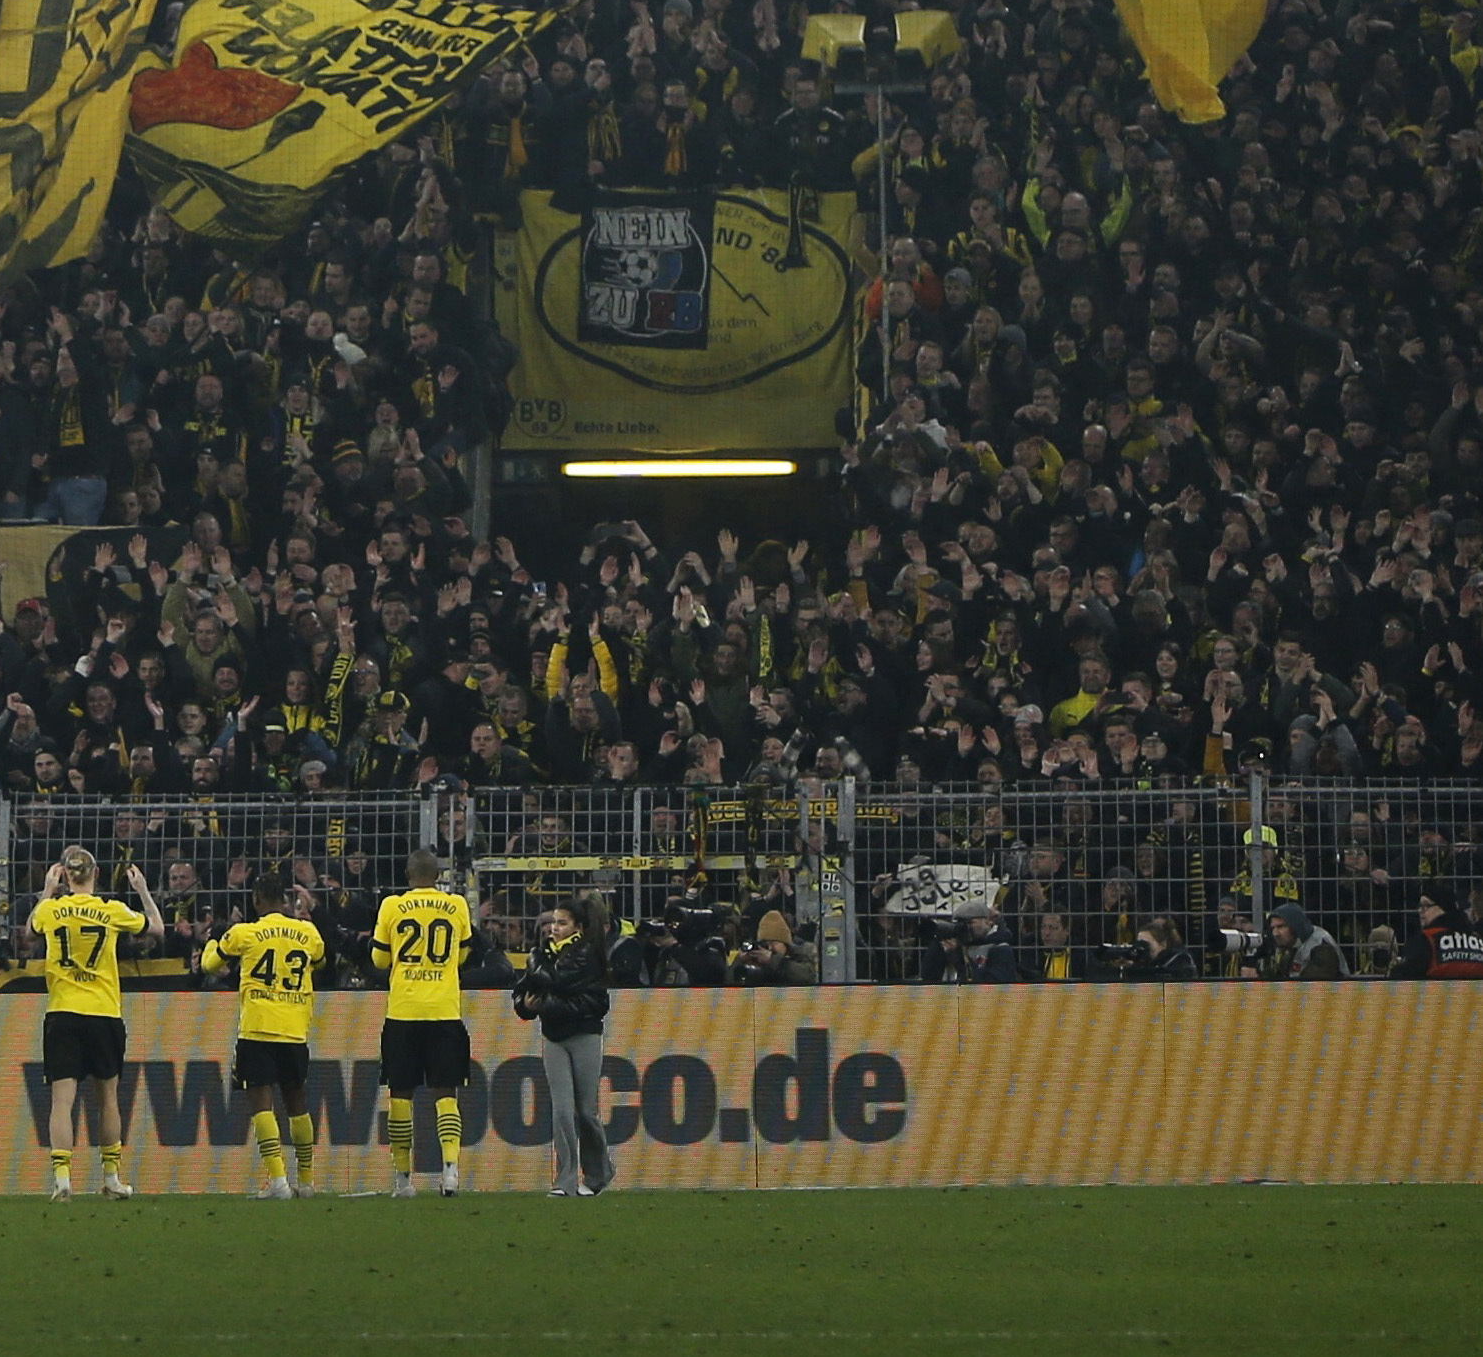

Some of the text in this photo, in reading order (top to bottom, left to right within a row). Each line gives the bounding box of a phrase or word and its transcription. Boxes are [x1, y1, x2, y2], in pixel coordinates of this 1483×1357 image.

[596, 209, 690, 248] NEIN
[717, 227, 752, 251] ND
[589, 287, 638, 327] ZU
[520, 399, 561, 422] BVB
[574, 422, 613, 433] Echte
[53, 906, 111, 924] DORTMUND
[398, 899, 457, 916] DORTMUND
[53, 925, 107, 969] 17
[255, 927, 309, 946] DORTMUND
[397, 918, 453, 964] 20
[250, 949, 310, 992] 43
[403, 969, 443, 981] MODESTE
